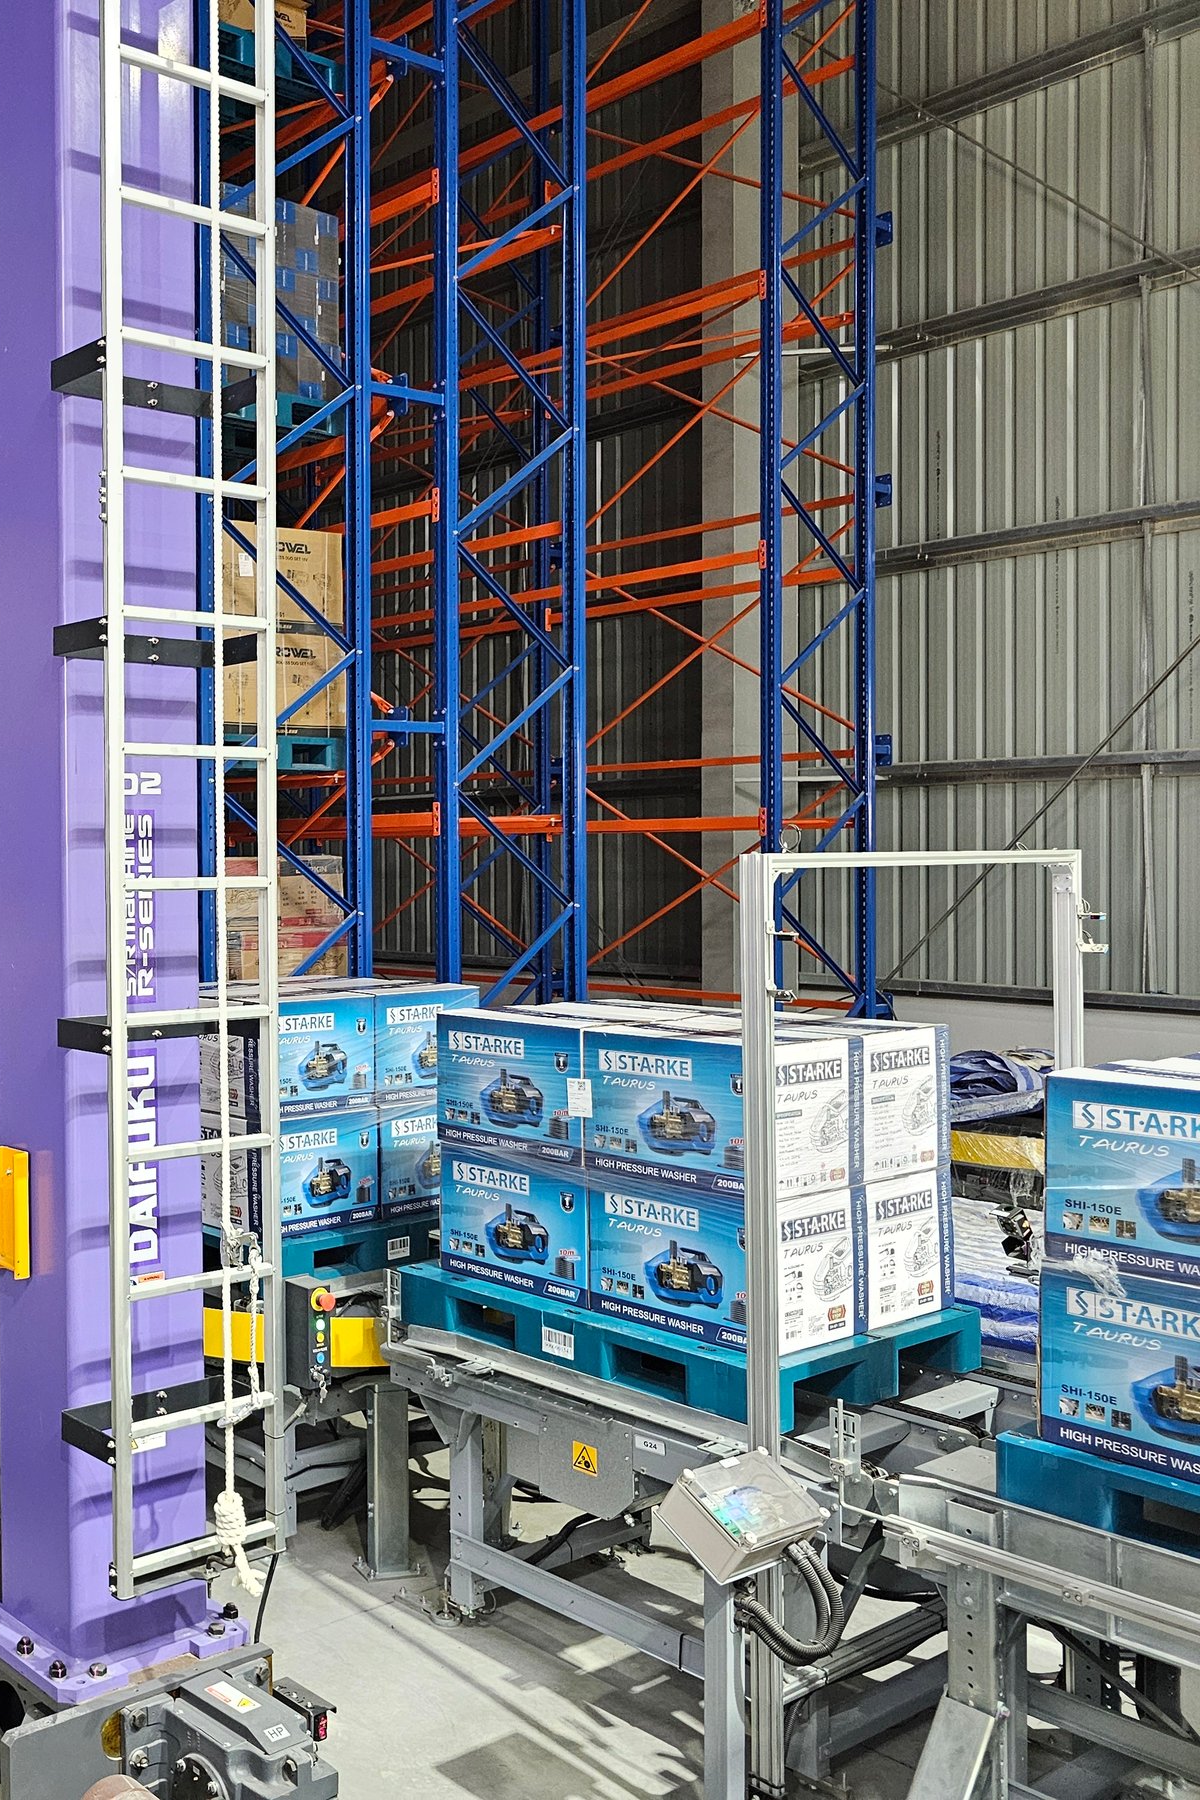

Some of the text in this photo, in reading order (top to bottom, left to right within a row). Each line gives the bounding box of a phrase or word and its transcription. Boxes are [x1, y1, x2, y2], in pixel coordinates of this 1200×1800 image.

[276, 541, 311, 555] OWEL
[389, 1026, 423, 1036] TAURUS
[279, 1035, 311, 1045] AURUS
[451, 1053, 496, 1068] TAURUS
[602, 1074, 657, 1091] TAURUS
[872, 1075, 909, 1090] TAURUS
[776, 1089, 818, 1104] TAURUS
[284, 1101, 338, 1113] PRESSURE WASHER
[595, 1124, 629, 1136] SHI-150E
[392, 1136, 427, 1148] TAURUS
[445, 1128, 528, 1151] HIGH PRESSURE WASHER
[1078, 1135, 1170, 1157] TAURUS
[126, 1055, 159, 1264] DAIFUKU
[541, 1146, 569, 1158] 200BAR
[595, 1157, 697, 1184] HIGH PRESSURE WASHER
[455, 1184, 501, 1201] TAURUS
[717, 1178, 745, 1191] 200BA
[390, 1197, 441, 1214] HIGH PRESSURE WAS
[1064, 1198, 1122, 1216] SHI-150E
[287, 1215, 342, 1233] PRESSURE WASHER
[608, 1217, 663, 1238] TAURUS
[877, 1221, 913, 1237] TAURUS
[450, 1228, 478, 1242] SHI-150E
[783, 1242, 824, 1259] TAURUS
[856, 1226, 864, 1278] PRESSURE
[1099, 1248, 1175, 1272] PRESSURE
[449, 1258, 535, 1289] HIGH PRESSURE WASHER
[601, 1266, 637, 1282] SHI-150E
[943, 1253, 951, 1294] WASHER
[547, 1284, 576, 1299] 200BAR
[601, 1299, 704, 1335] HIGH PRESSURE WASHER
[721, 1331, 747, 1345] 200BA
[1073, 1321, 1163, 1351] TAURUS
[1061, 1384, 1118, 1406] SHI-150E
[643, 1440, 658, 1450] G24
[1060, 1427, 1200, 1476] HIGH PRESSURE WAS
[267, 1726, 285, 1739] HP
